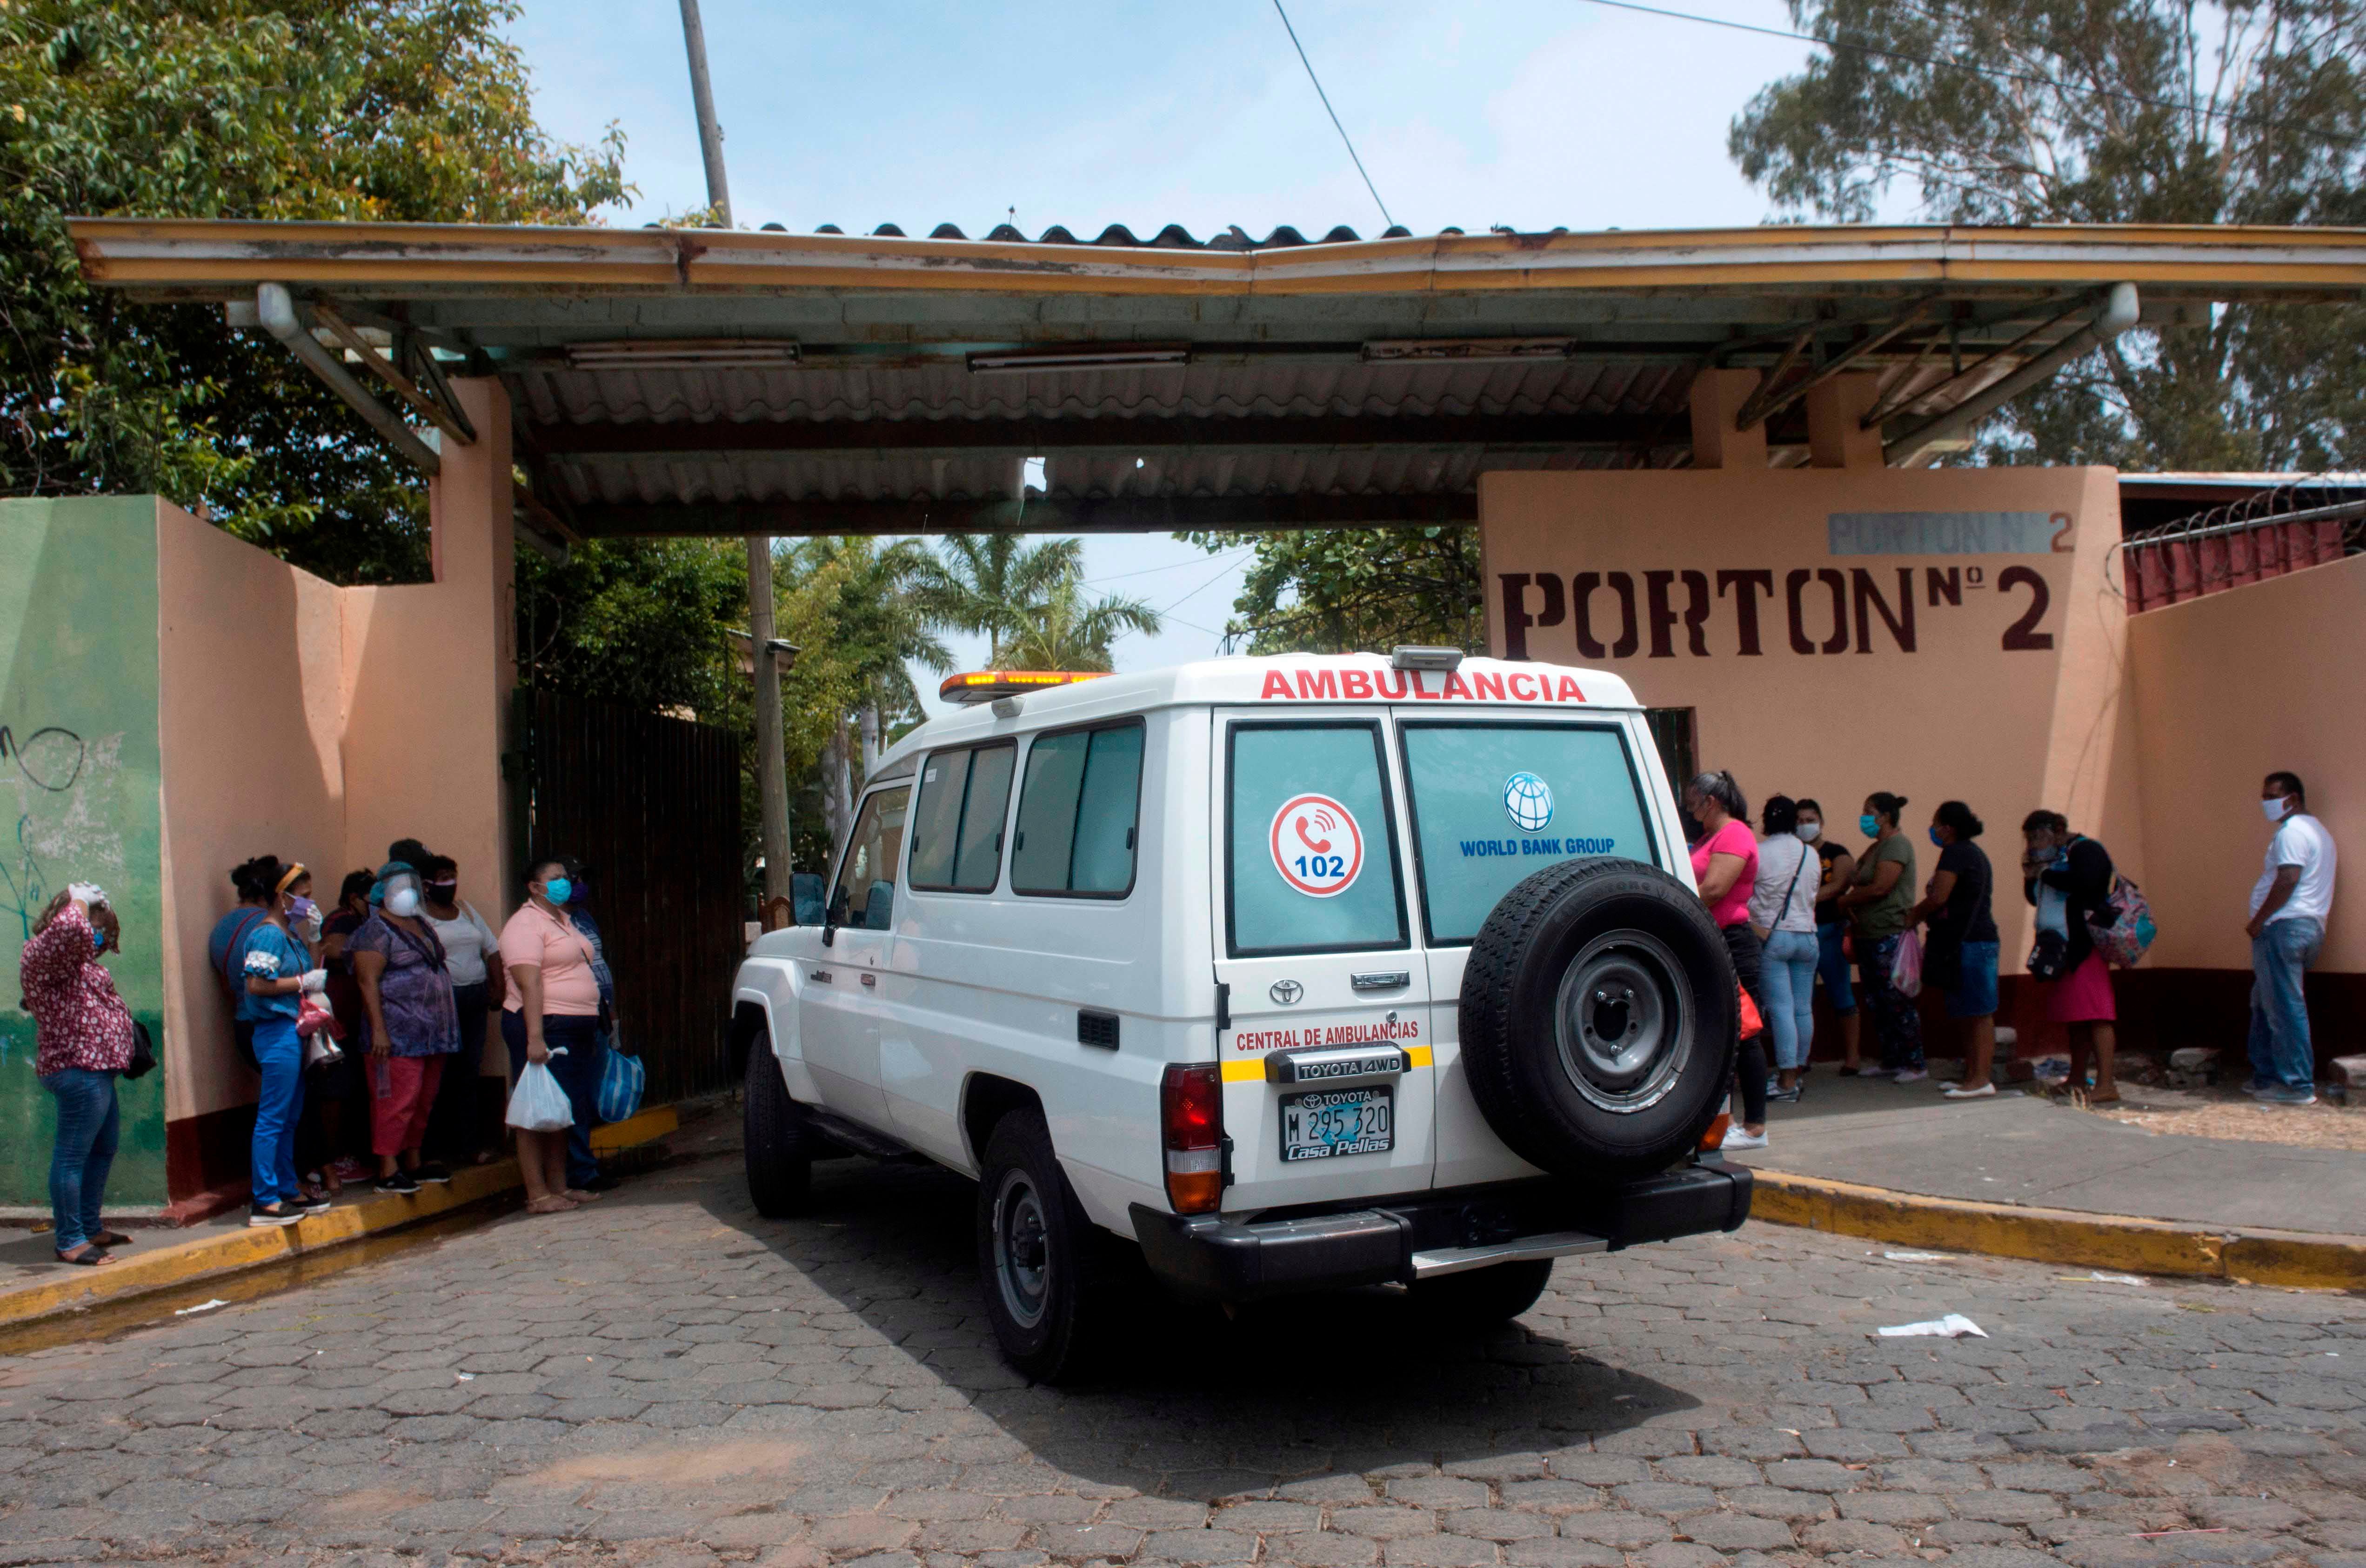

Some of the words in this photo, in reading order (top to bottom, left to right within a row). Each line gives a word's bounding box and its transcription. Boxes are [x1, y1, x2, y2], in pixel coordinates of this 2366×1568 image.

[2049, 513, 2075, 552] 2
[1497, 566, 1917, 661] PORTON
[1998, 565, 2053, 650] 2
[1260, 669, 1588, 702] AMBULANCIA
[1459, 840, 1518, 857] WORLD
[1521, 839, 1562, 855] BANK
[1565, 838, 1615, 854] GROUP
[1295, 855, 1345, 878] 102
[1236, 1030, 1300, 1051] CENTRAL
[1304, 1028, 1321, 1046] DE
[1325, 1021, 1418, 1044] AMBULANCIAS
[1301, 1062, 1360, 1079] TOYOTA
[1363, 1057, 1401, 1074] 4WD
[1323, 1091, 1372, 1106] TOYOTA
[1288, 1113, 1300, 1142] M
[1308, 1108, 1344, 1140] 295
[1287, 1145, 1331, 1161] Casa
[1335, 1137, 1390, 1156] Pellas
